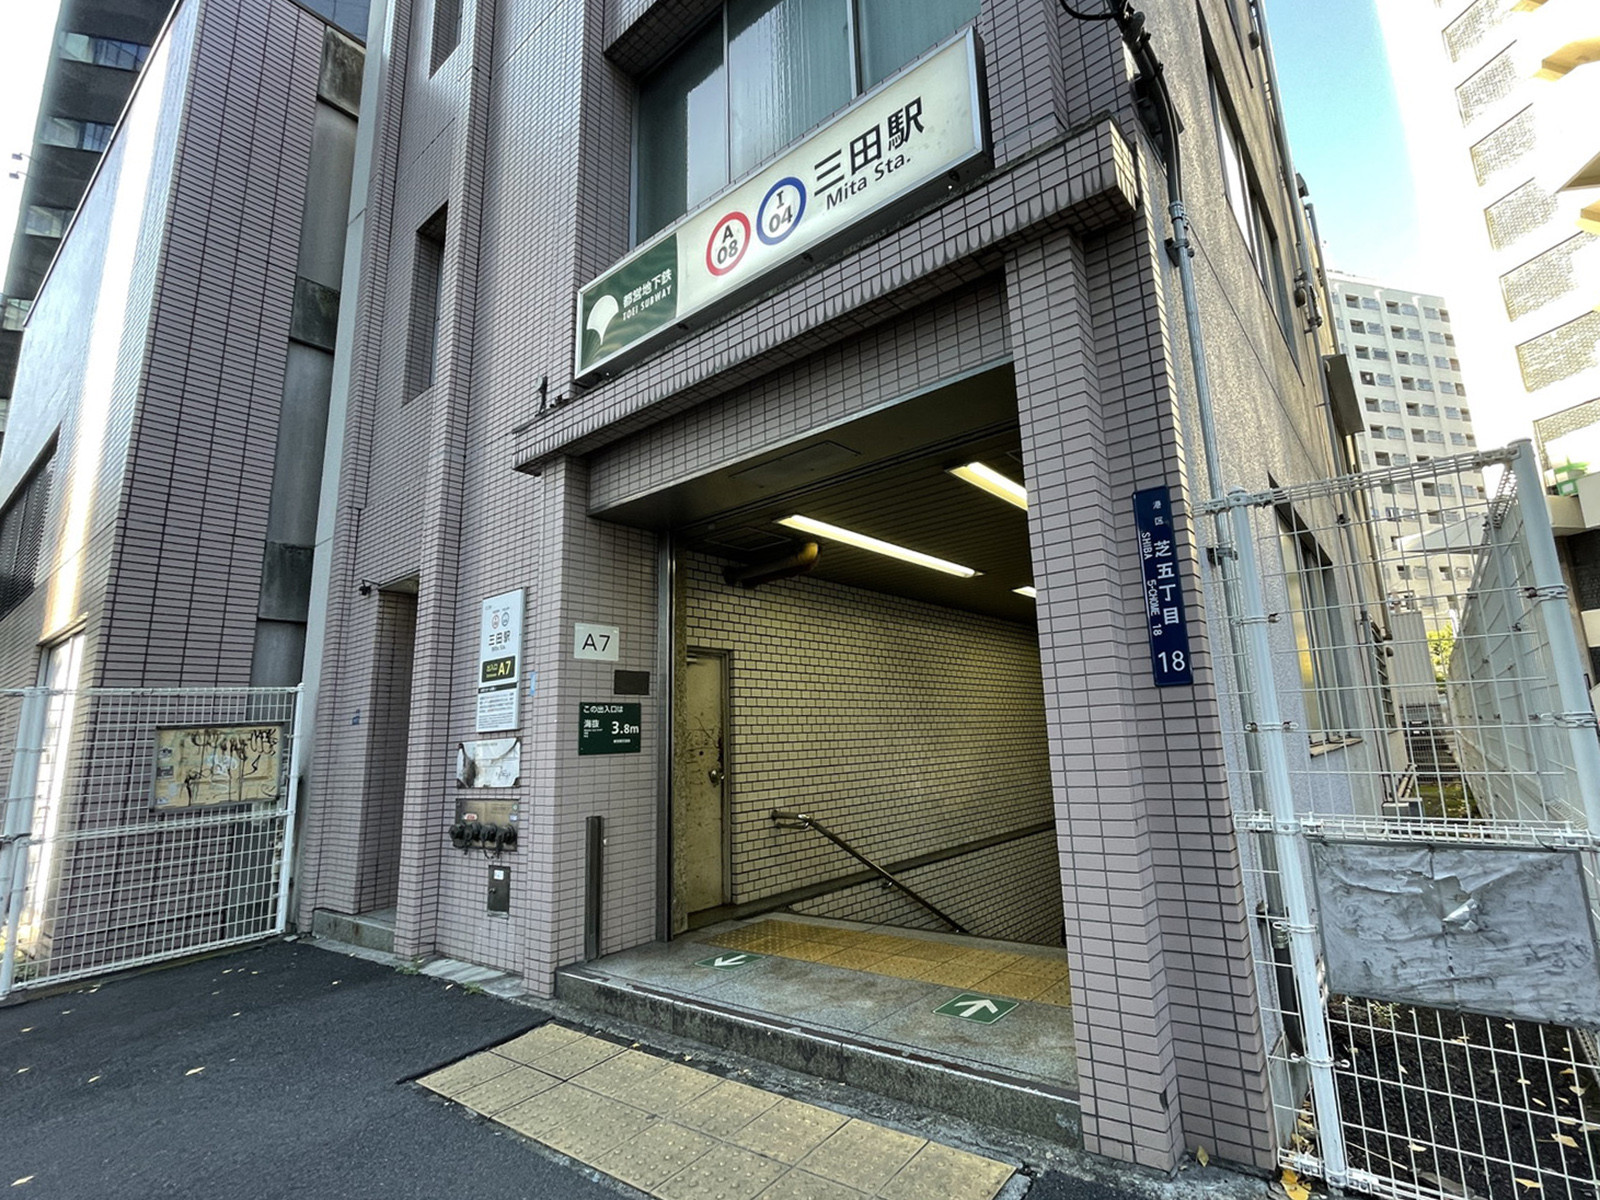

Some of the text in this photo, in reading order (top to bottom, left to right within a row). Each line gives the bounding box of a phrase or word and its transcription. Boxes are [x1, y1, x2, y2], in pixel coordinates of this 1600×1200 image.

[813, 96, 925, 197] 三田駅
[826, 152, 911, 211] Mita Sta.
[776, 190, 785, 210] I
[768, 203, 794, 234] 04
[722, 225, 734, 244] A
[716, 239, 739, 265] 08
[623, 268, 672, 308] 都営地下鉄
[622, 284, 672, 321] TOEI SUBWAY
[1141, 531, 1163, 637] SHIBA 5-CHOME 18
[1153, 539, 1180, 626] 芝五丁目
[582, 633, 611, 652] A7
[498, 660, 512, 676] A7
[1157, 650, 1186, 673] 18
[583, 705, 624, 714] この出入口は
[611, 720, 640, 735] 3.8m
